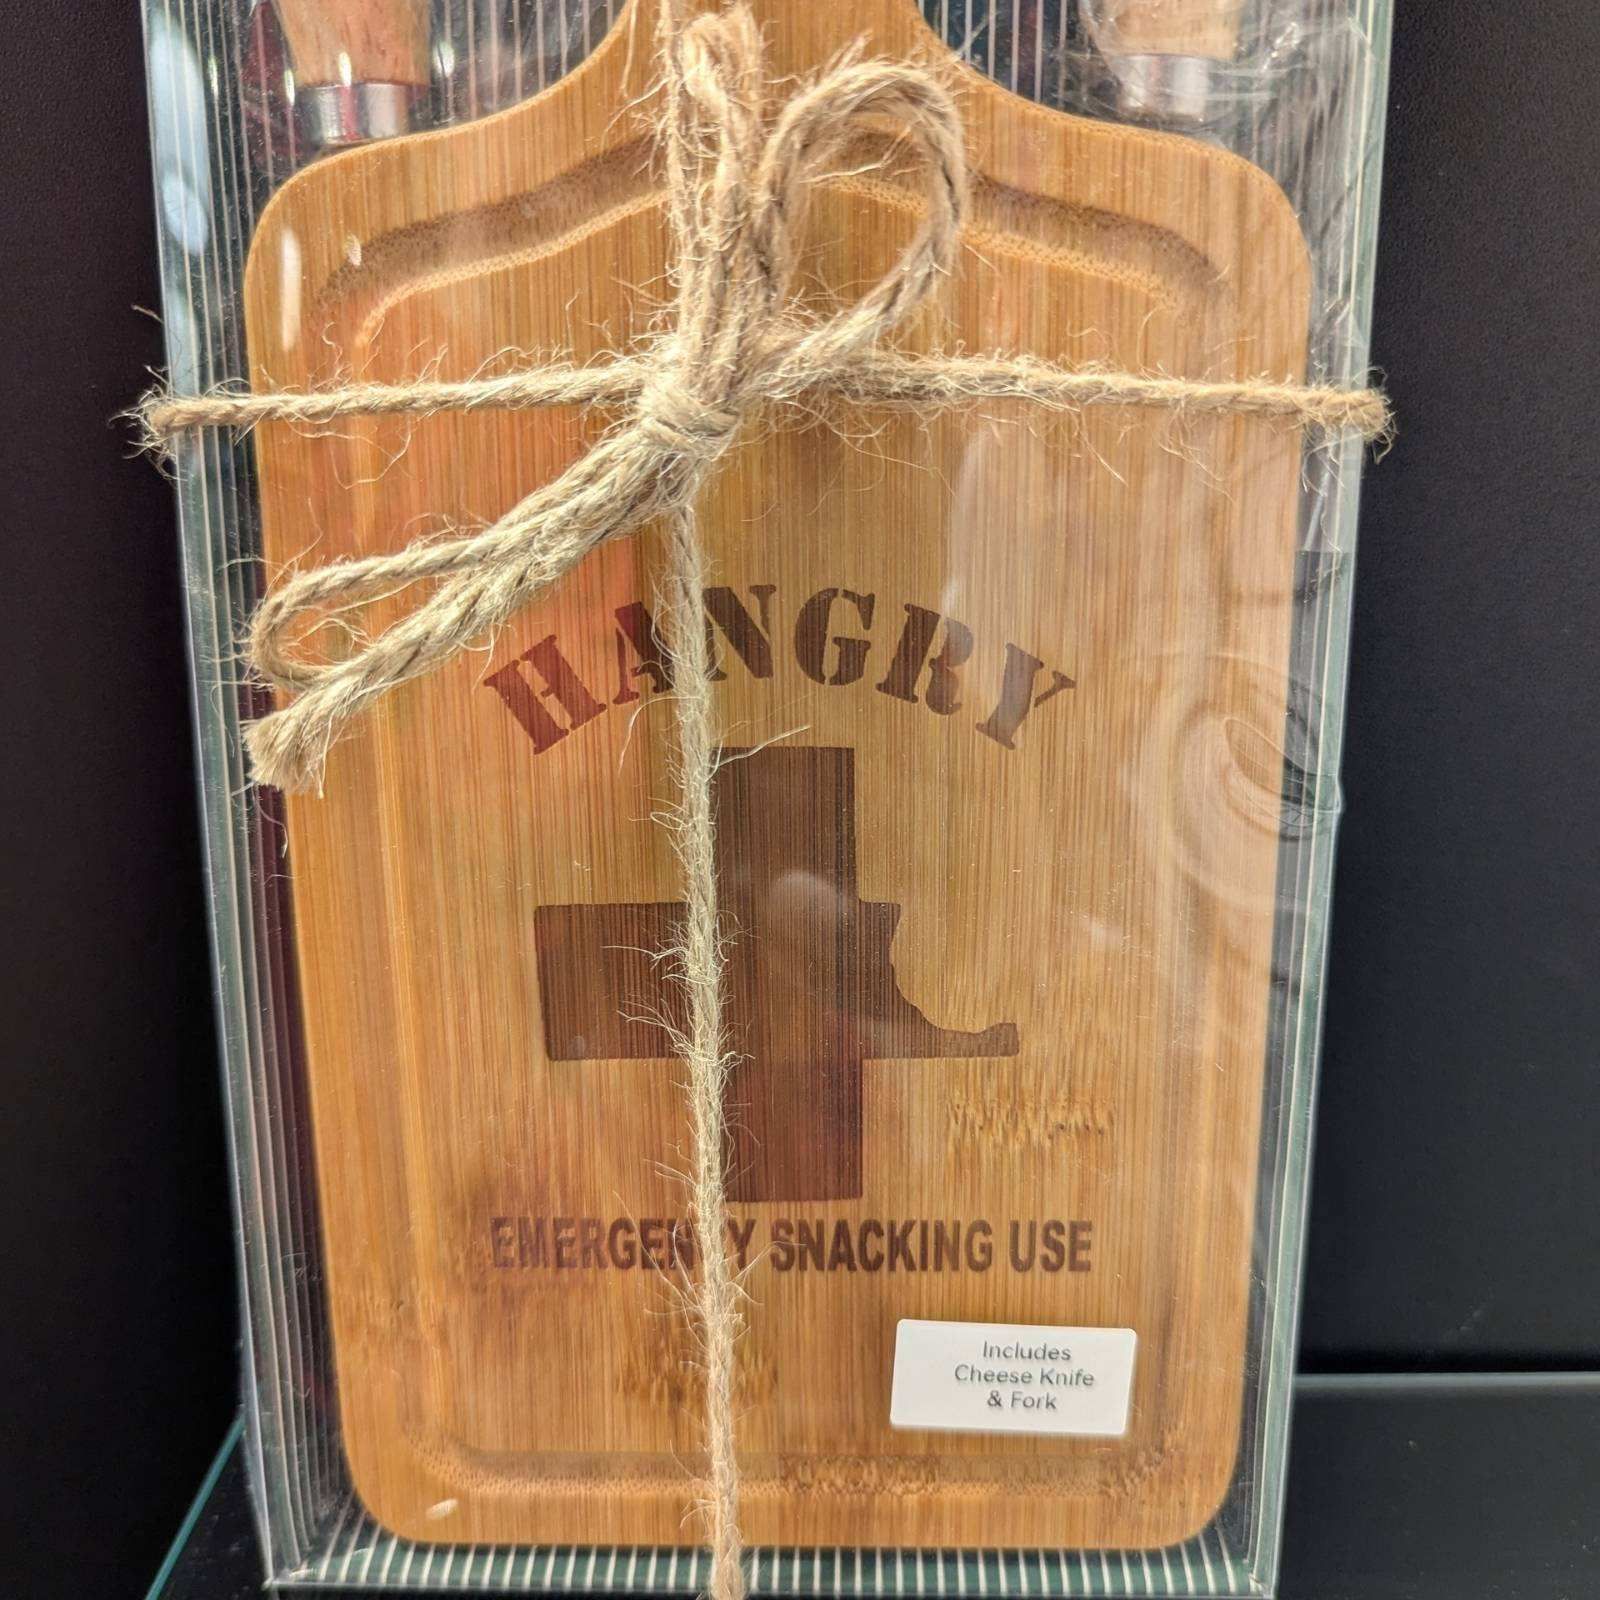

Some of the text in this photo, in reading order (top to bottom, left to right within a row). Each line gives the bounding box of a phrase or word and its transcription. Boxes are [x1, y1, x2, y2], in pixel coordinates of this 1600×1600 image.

[483, 584, 1077, 755] HANGRY
[490, 1217, 1093, 1272] EMERGENY SNACKING USE
[982, 1341, 1072, 1361] Includes
[954, 1364, 1095, 1387] Cheese Knife
[987, 1390, 1057, 1410] & Fork
